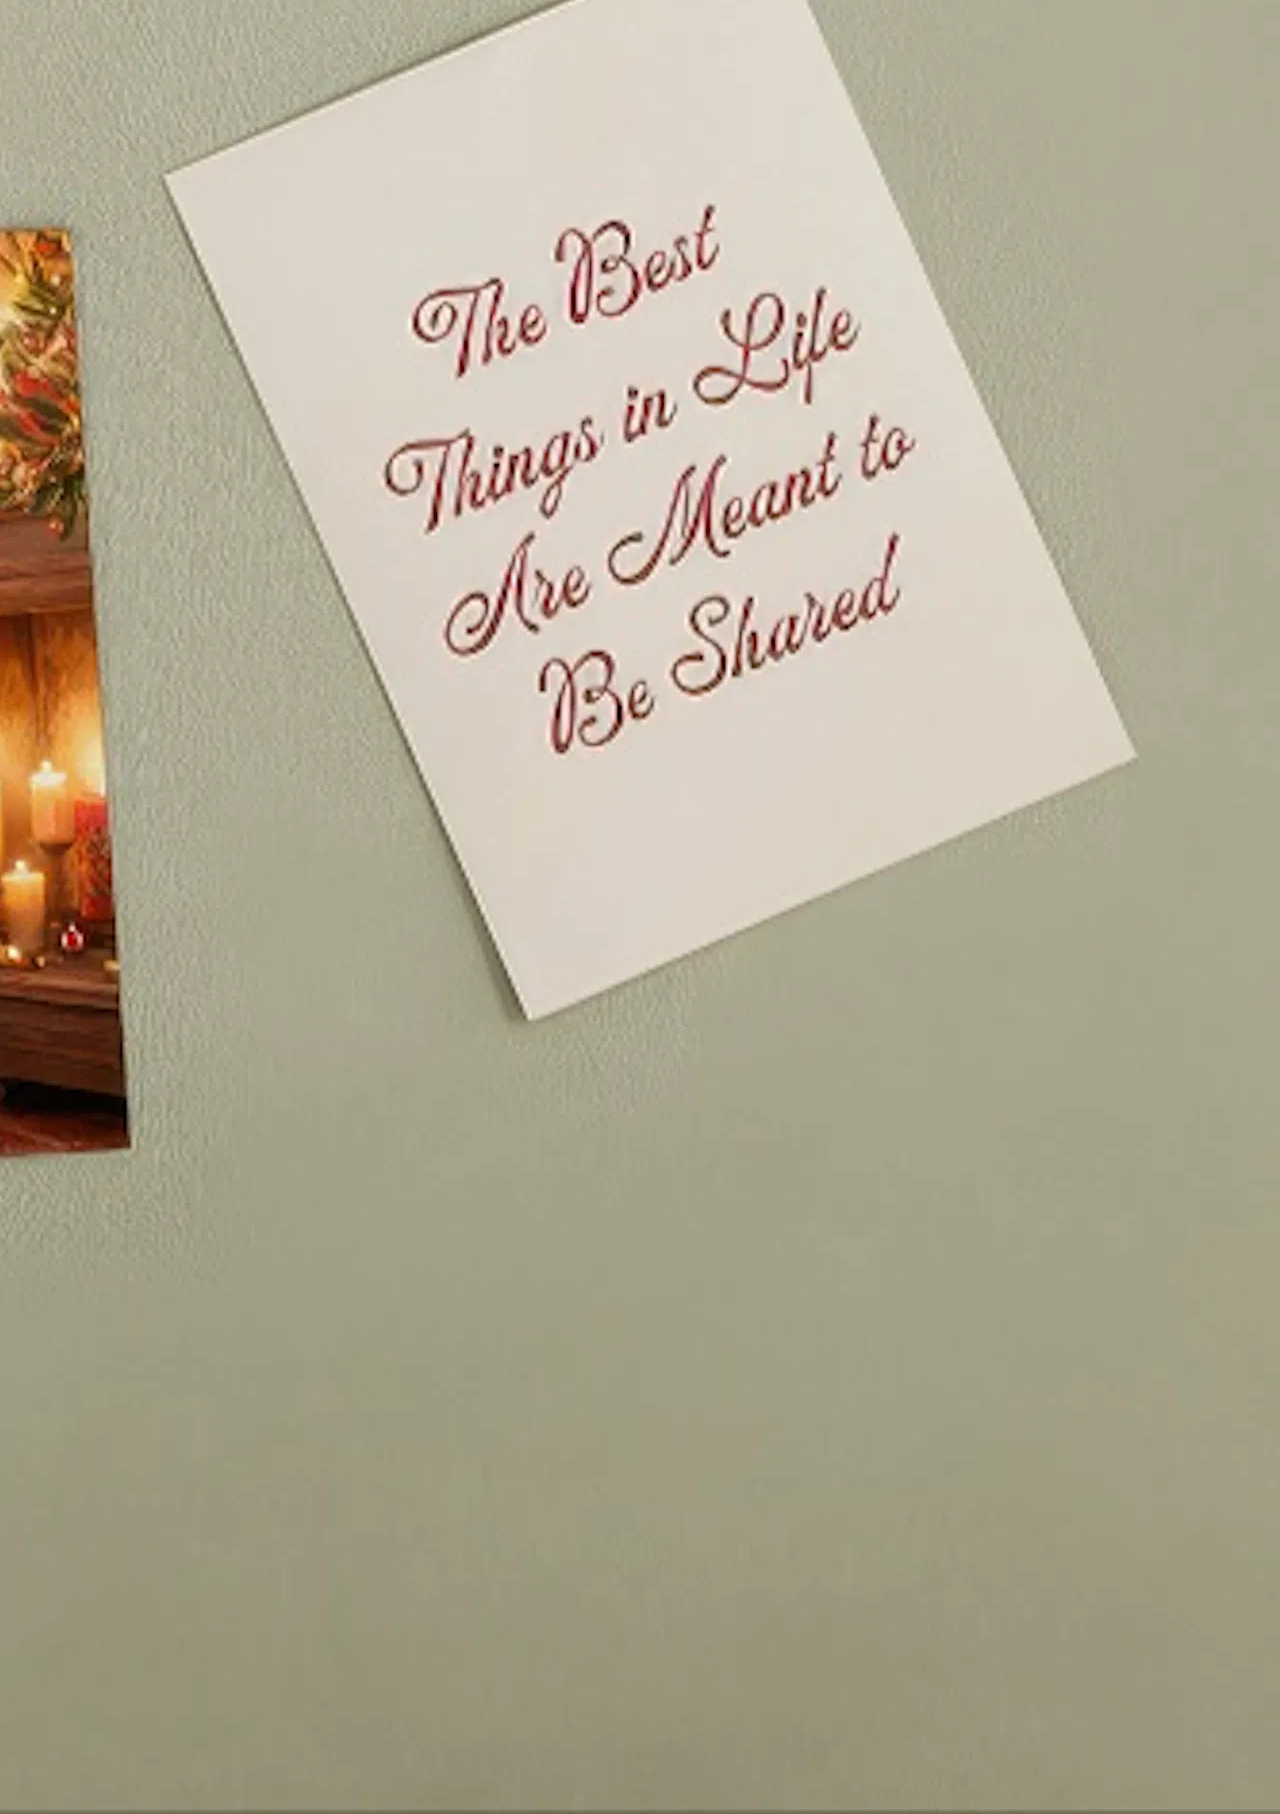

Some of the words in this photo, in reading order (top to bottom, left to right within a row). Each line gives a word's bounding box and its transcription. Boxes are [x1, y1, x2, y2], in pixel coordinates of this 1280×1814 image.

[410, 277, 548, 377] The
[552, 204, 722, 326] Best
[382, 417, 606, 533] Things
[621, 381, 678, 446] in
[691, 287, 860, 405] Life
[443, 530, 593, 658] Are
[606, 453, 844, 587] Meant
[857, 413, 918, 482] to
[536, 648, 657, 755] Be
[670, 532, 902, 696] Shared
